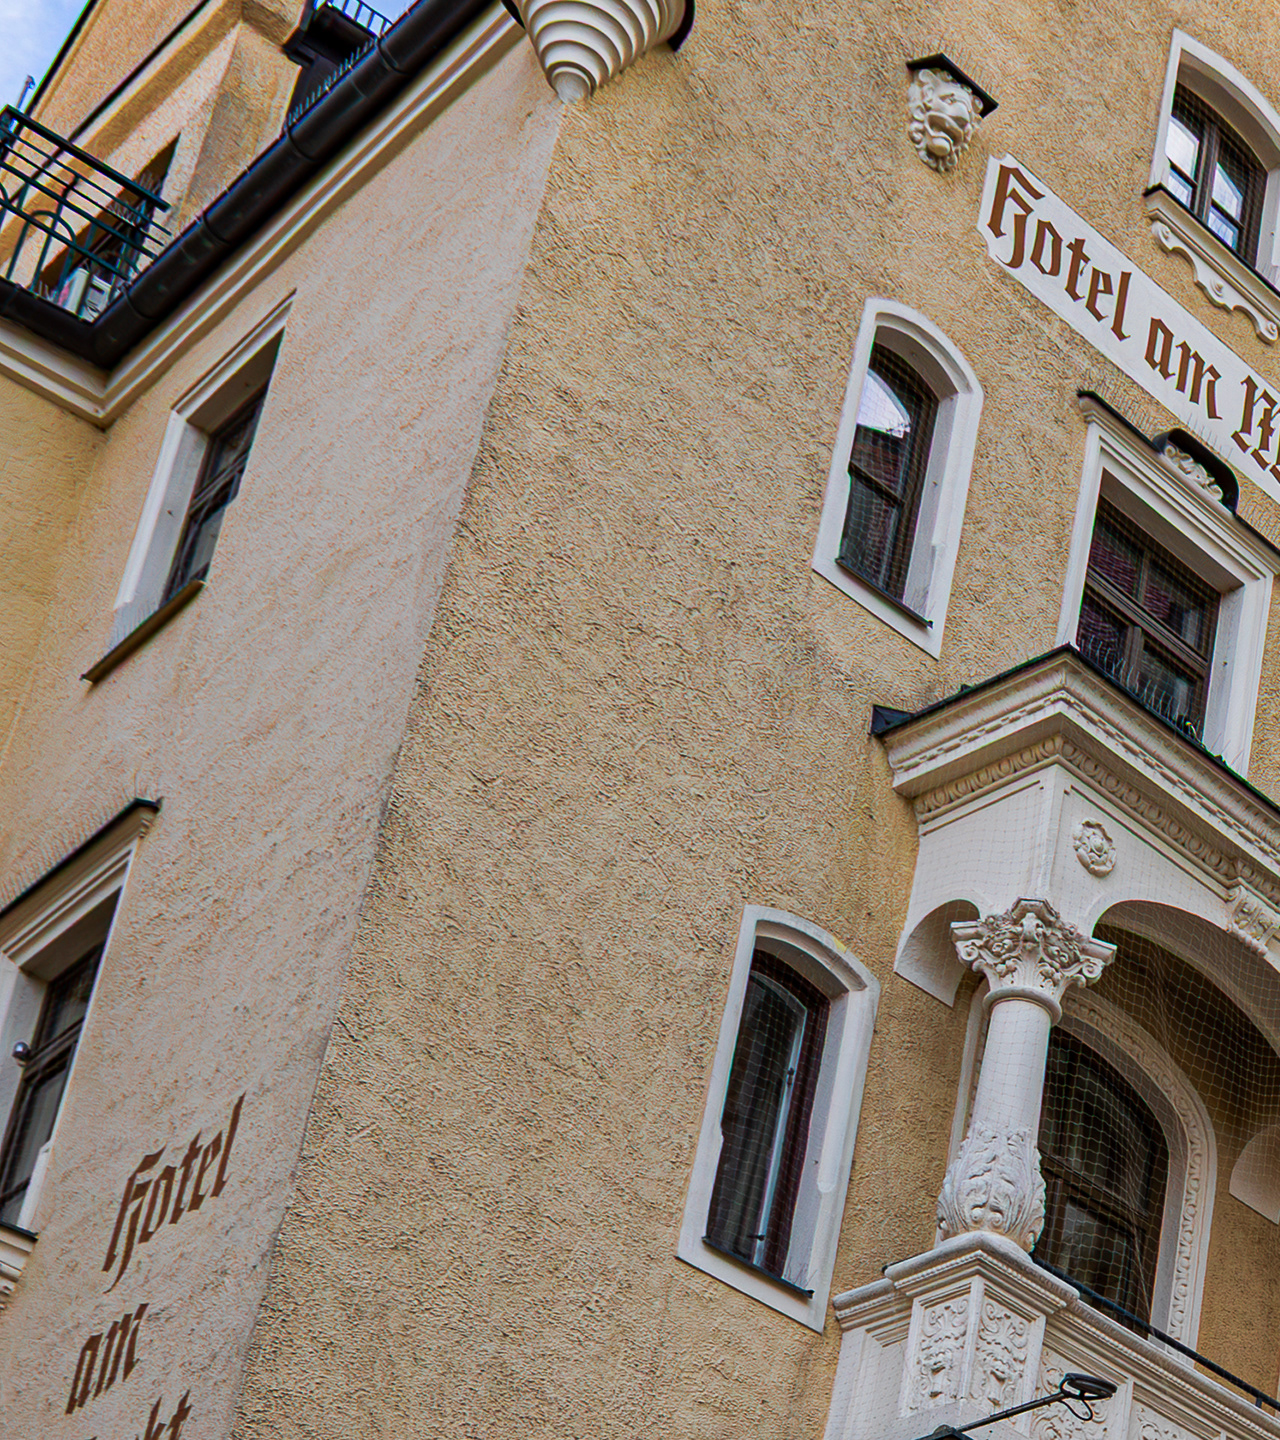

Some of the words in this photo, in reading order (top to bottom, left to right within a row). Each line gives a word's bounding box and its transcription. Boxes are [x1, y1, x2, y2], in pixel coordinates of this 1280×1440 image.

[986, 164, 1132, 342] Hotel
[1143, 316, 1222, 421] am
[102, 1090, 247, 1294] Hotel
[65, 1302, 150, 1415] am
